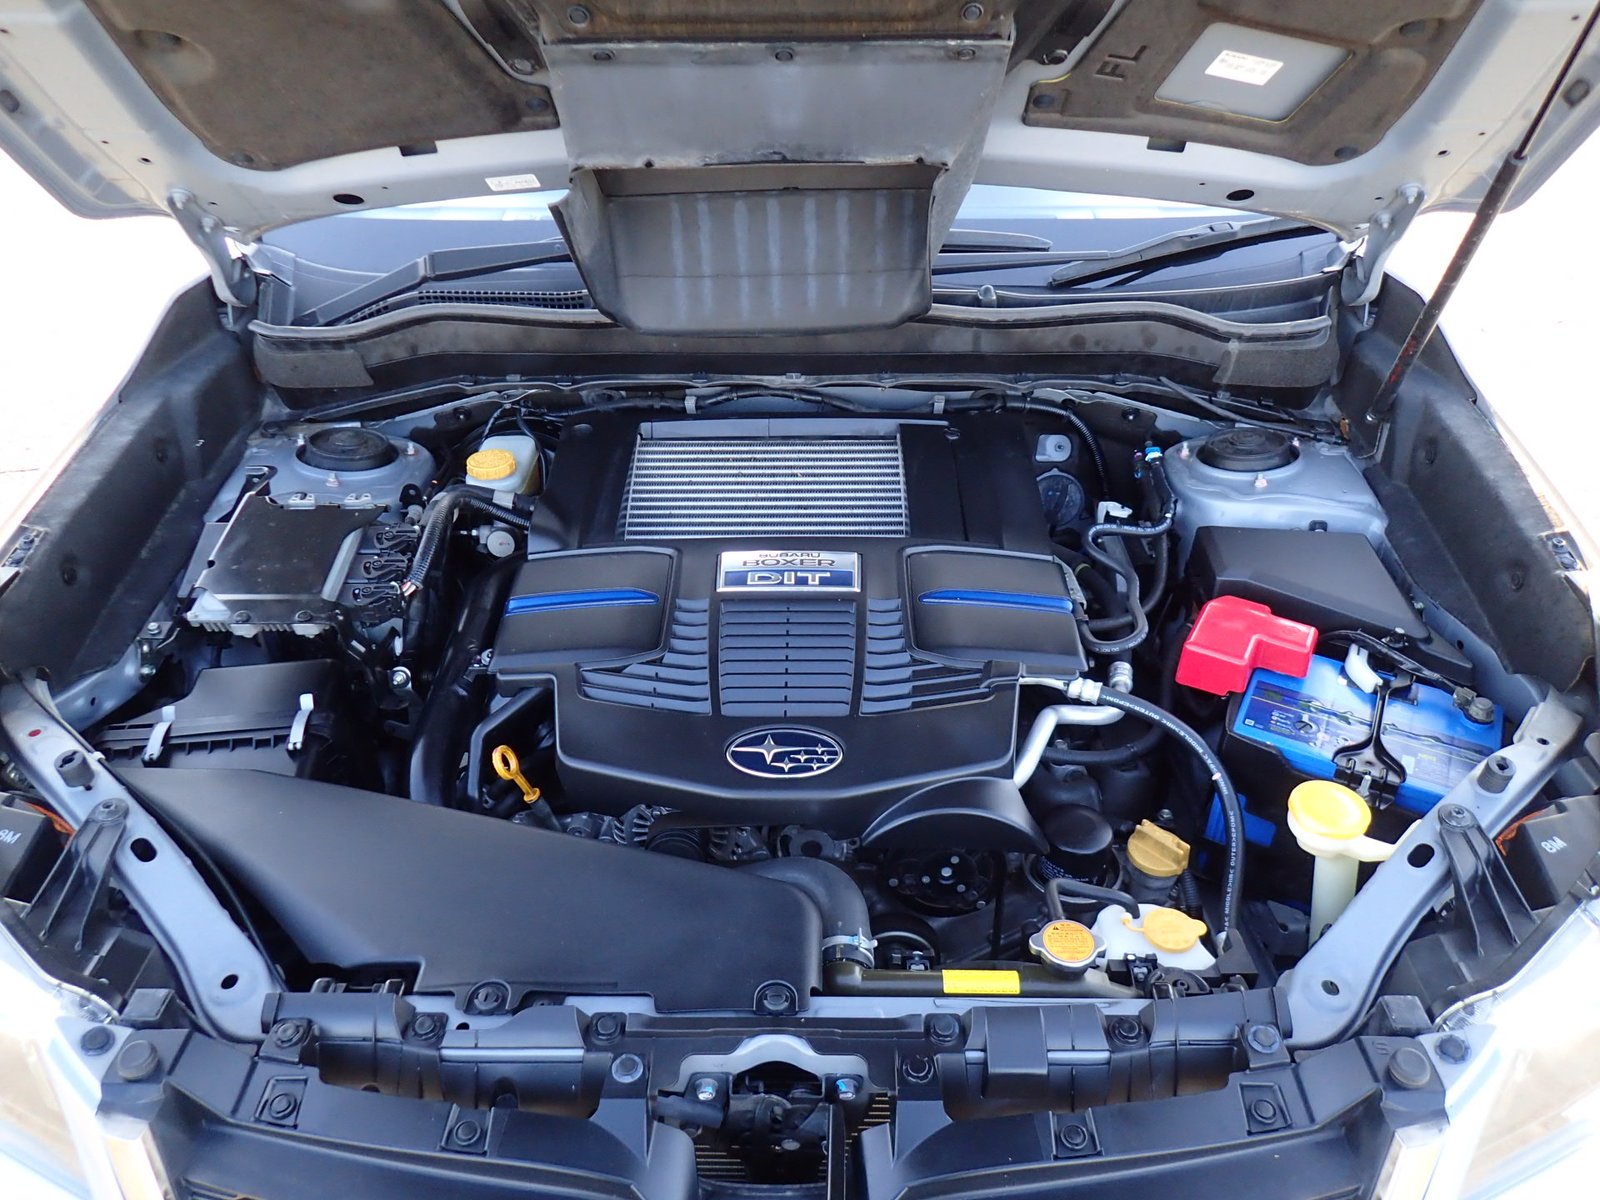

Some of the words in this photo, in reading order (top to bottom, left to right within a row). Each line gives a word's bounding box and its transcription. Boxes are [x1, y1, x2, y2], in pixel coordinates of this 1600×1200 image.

[1095, 45, 1147, 80] FL
[742, 558, 836, 567] BOXER
[747, 571, 831, 585] DIT
